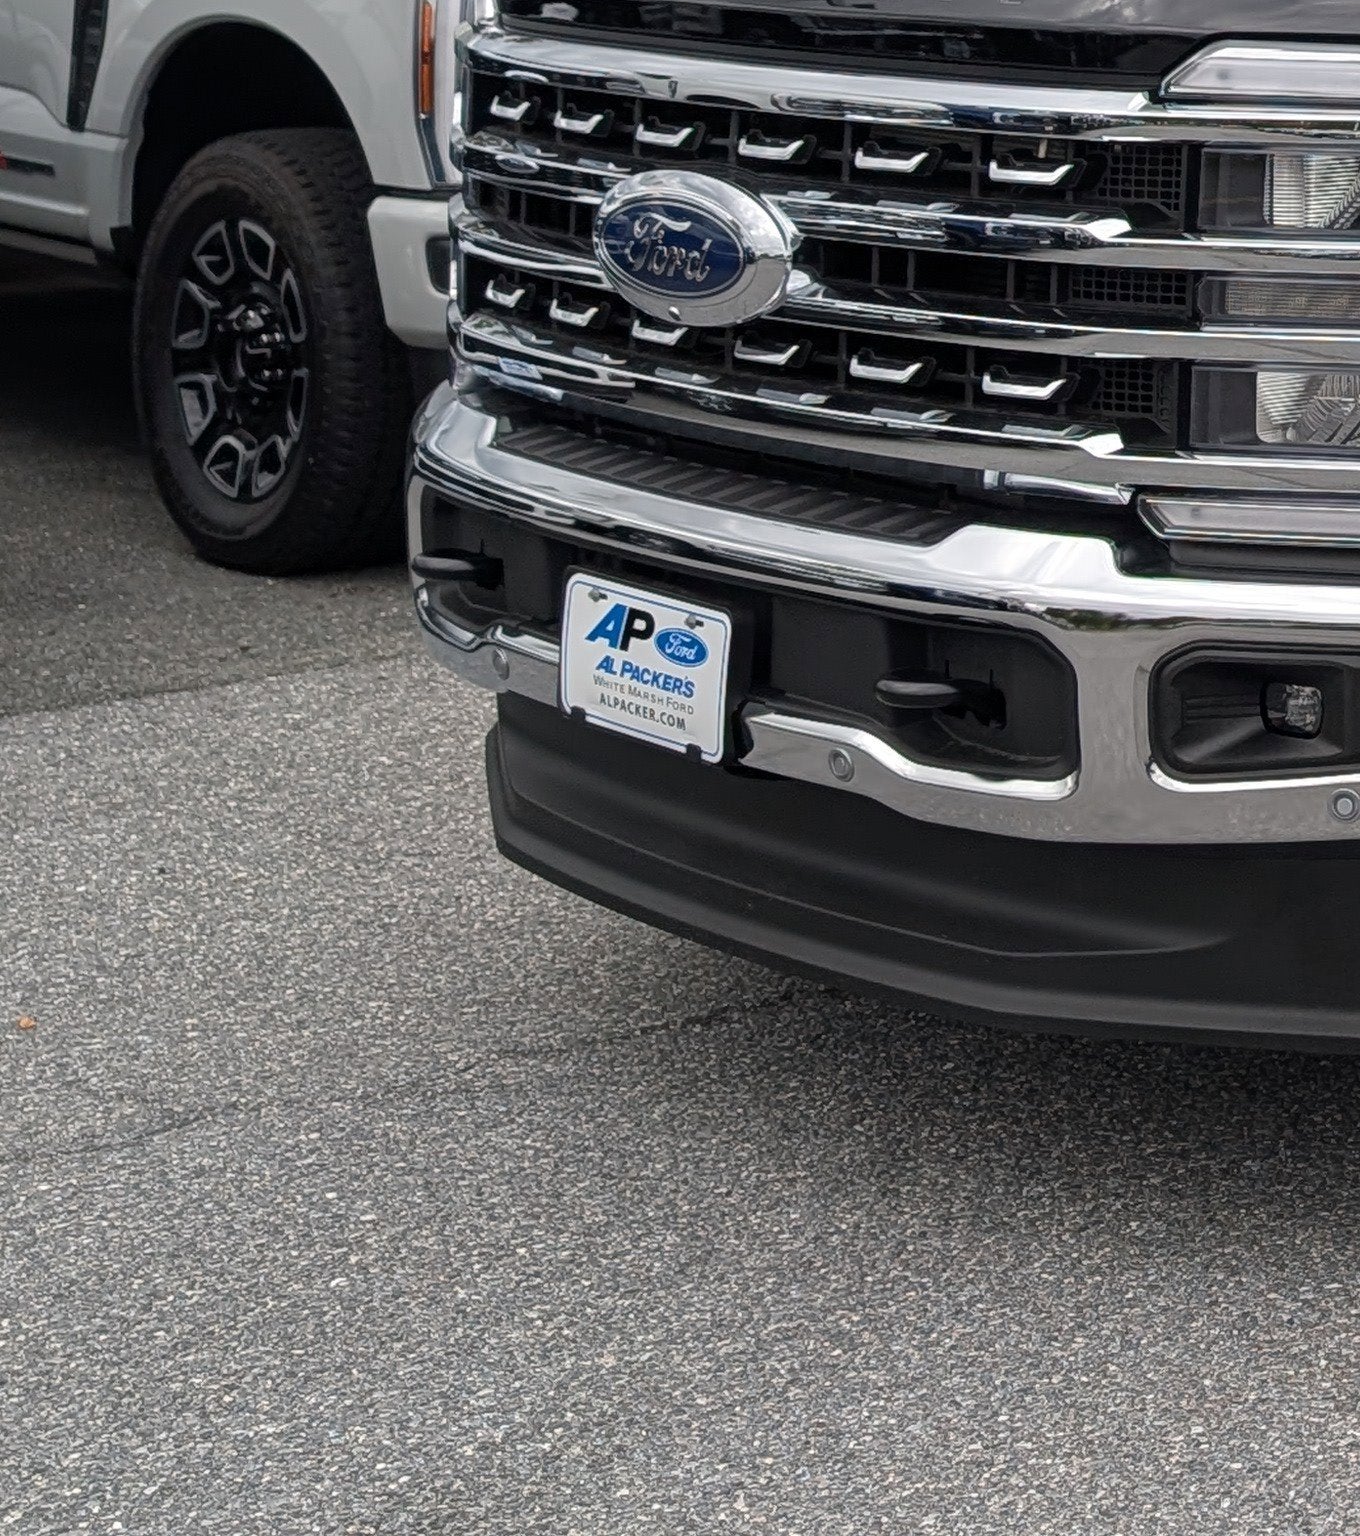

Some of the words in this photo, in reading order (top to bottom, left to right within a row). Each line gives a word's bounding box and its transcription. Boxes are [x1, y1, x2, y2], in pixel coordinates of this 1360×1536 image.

[627, 210, 712, 285] Ford
[584, 603, 656, 653] AP
[664, 633, 697, 661] Ford
[592, 674, 626, 694] WHITE
[627, 685, 665, 705] MARSH
[665, 696, 694, 715] FORD
[595, 654, 618, 677] AL
[619, 663, 695, 699] PACKER'S
[599, 692, 687, 731] ALPACKER.COM
